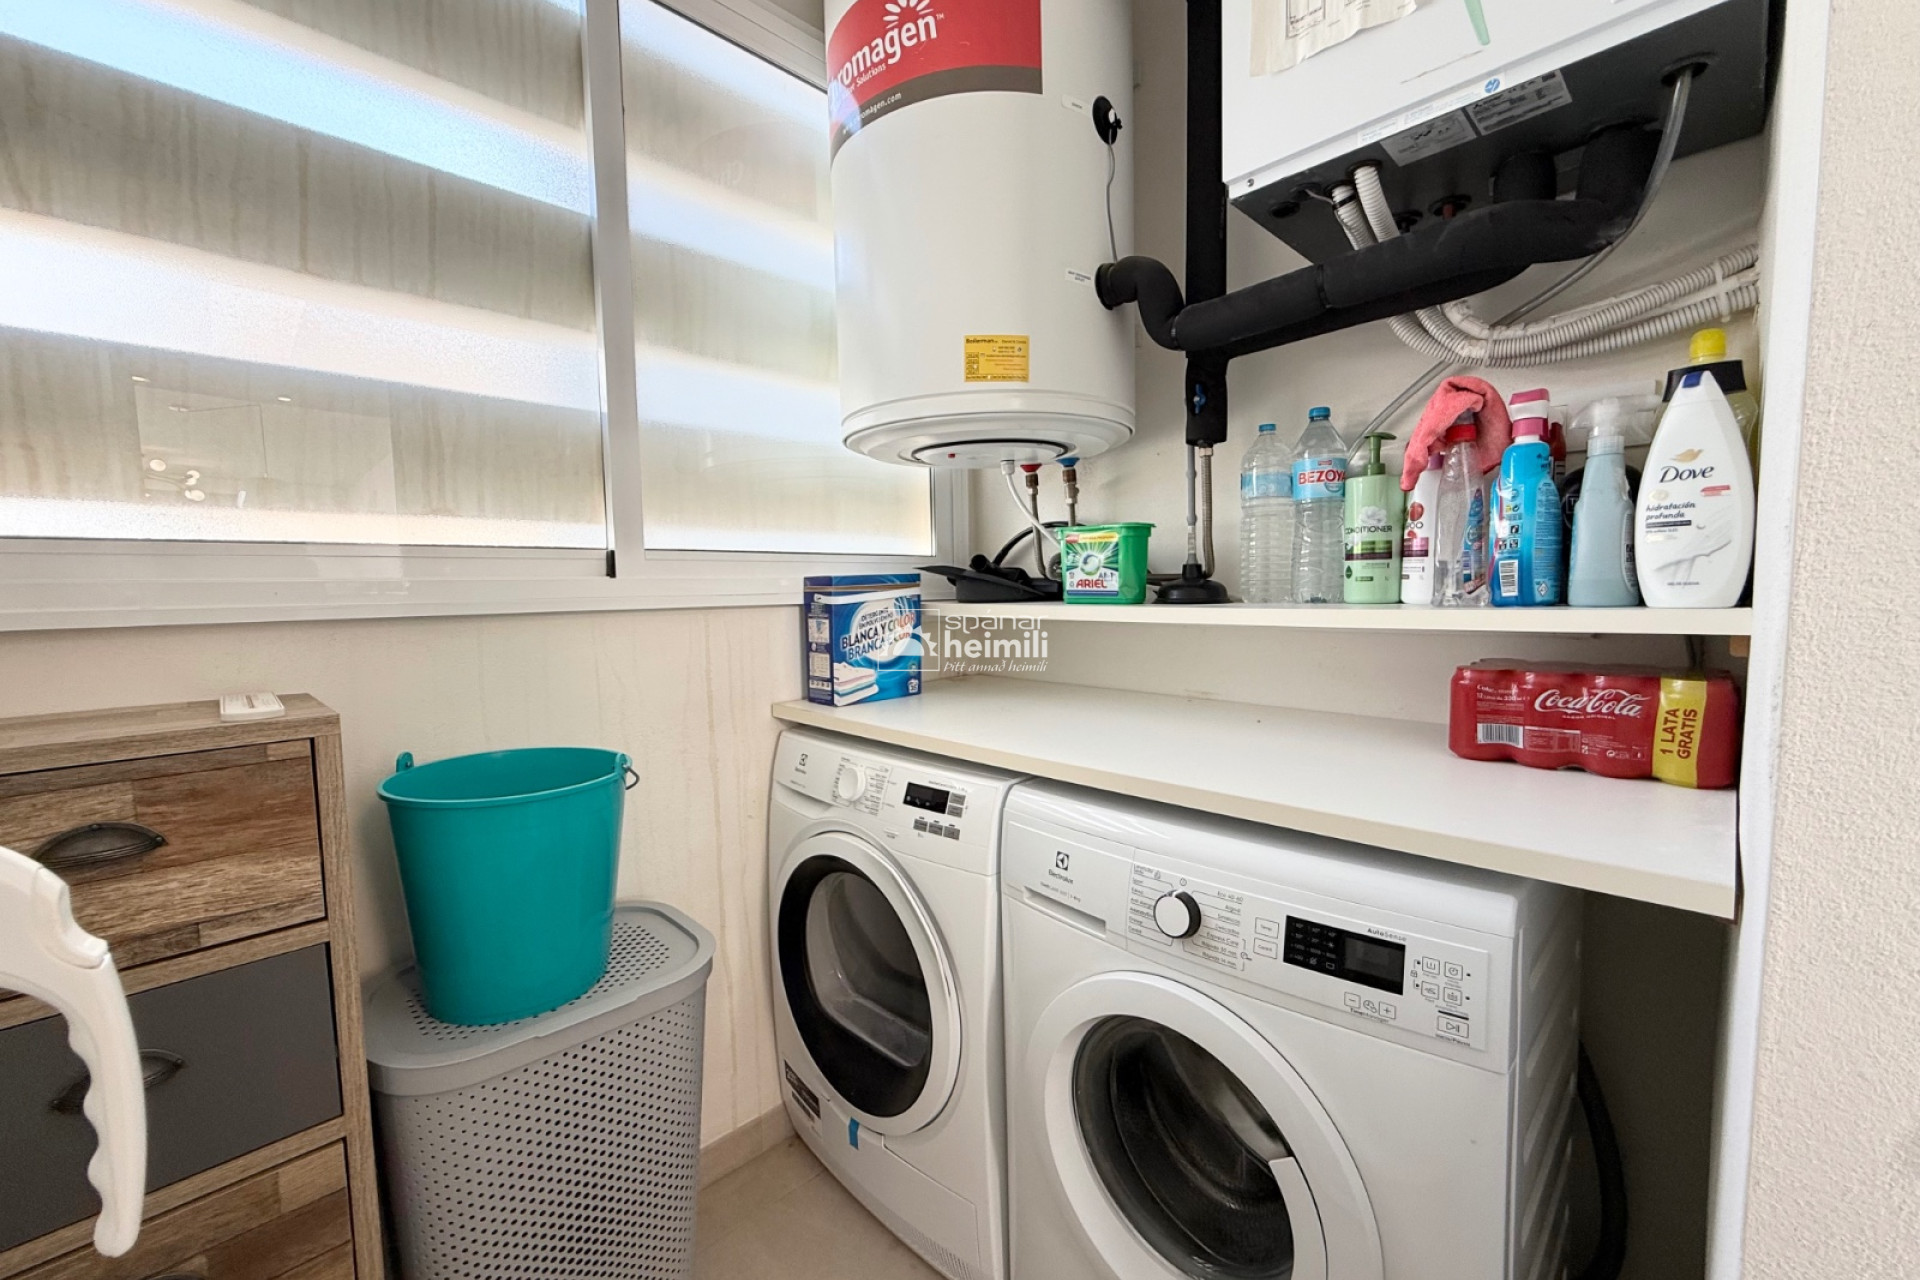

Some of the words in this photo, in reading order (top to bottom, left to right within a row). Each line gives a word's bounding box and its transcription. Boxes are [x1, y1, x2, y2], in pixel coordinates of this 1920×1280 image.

[837, 15, 937, 86] romagen
[1659, 465, 1715, 483] Dove
[1646, 501, 1696, 512] hidratación
[1645, 511, 1685, 521] profunda
[1345, 525, 1392, 535] CONDITIONER
[1076, 579, 1107, 589] ARIEL
[842, 626, 878, 650] BLANCA
[880, 622, 887, 635] Y
[888, 611, 916, 632] COLOR
[848, 636, 885, 660] BRANCA
[1661, 708, 1680, 743] LATA
[1677, 708, 1698, 759] GRATIS
[1367, 927, 1407, 942] AutoSense
